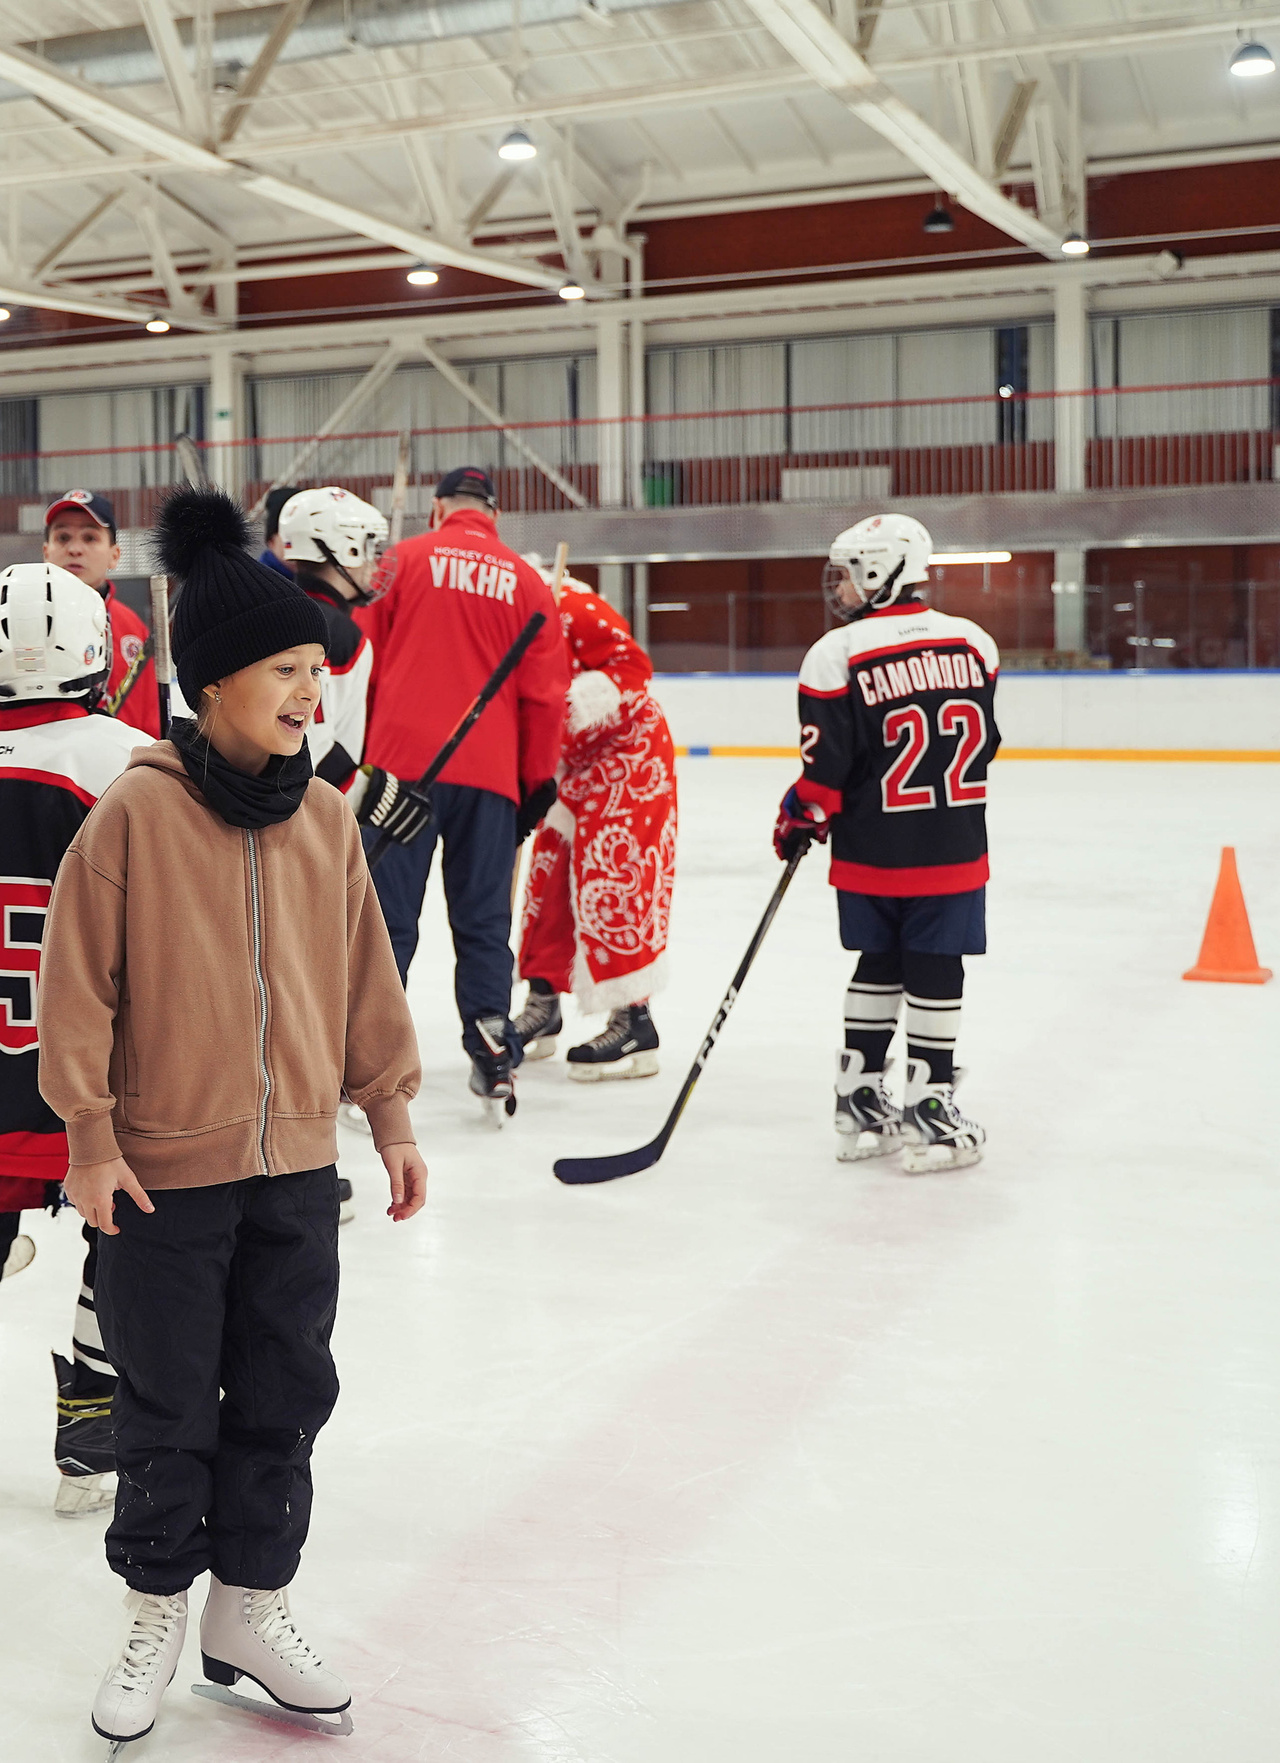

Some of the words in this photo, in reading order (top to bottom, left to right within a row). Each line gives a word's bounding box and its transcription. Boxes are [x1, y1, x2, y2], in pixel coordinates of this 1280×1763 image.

[428, 555, 518, 607] VIKHR
[434, 546, 483, 561] HOCKEY
[483, 553, 516, 571] CLUB
[880, 699, 988, 812] 22
